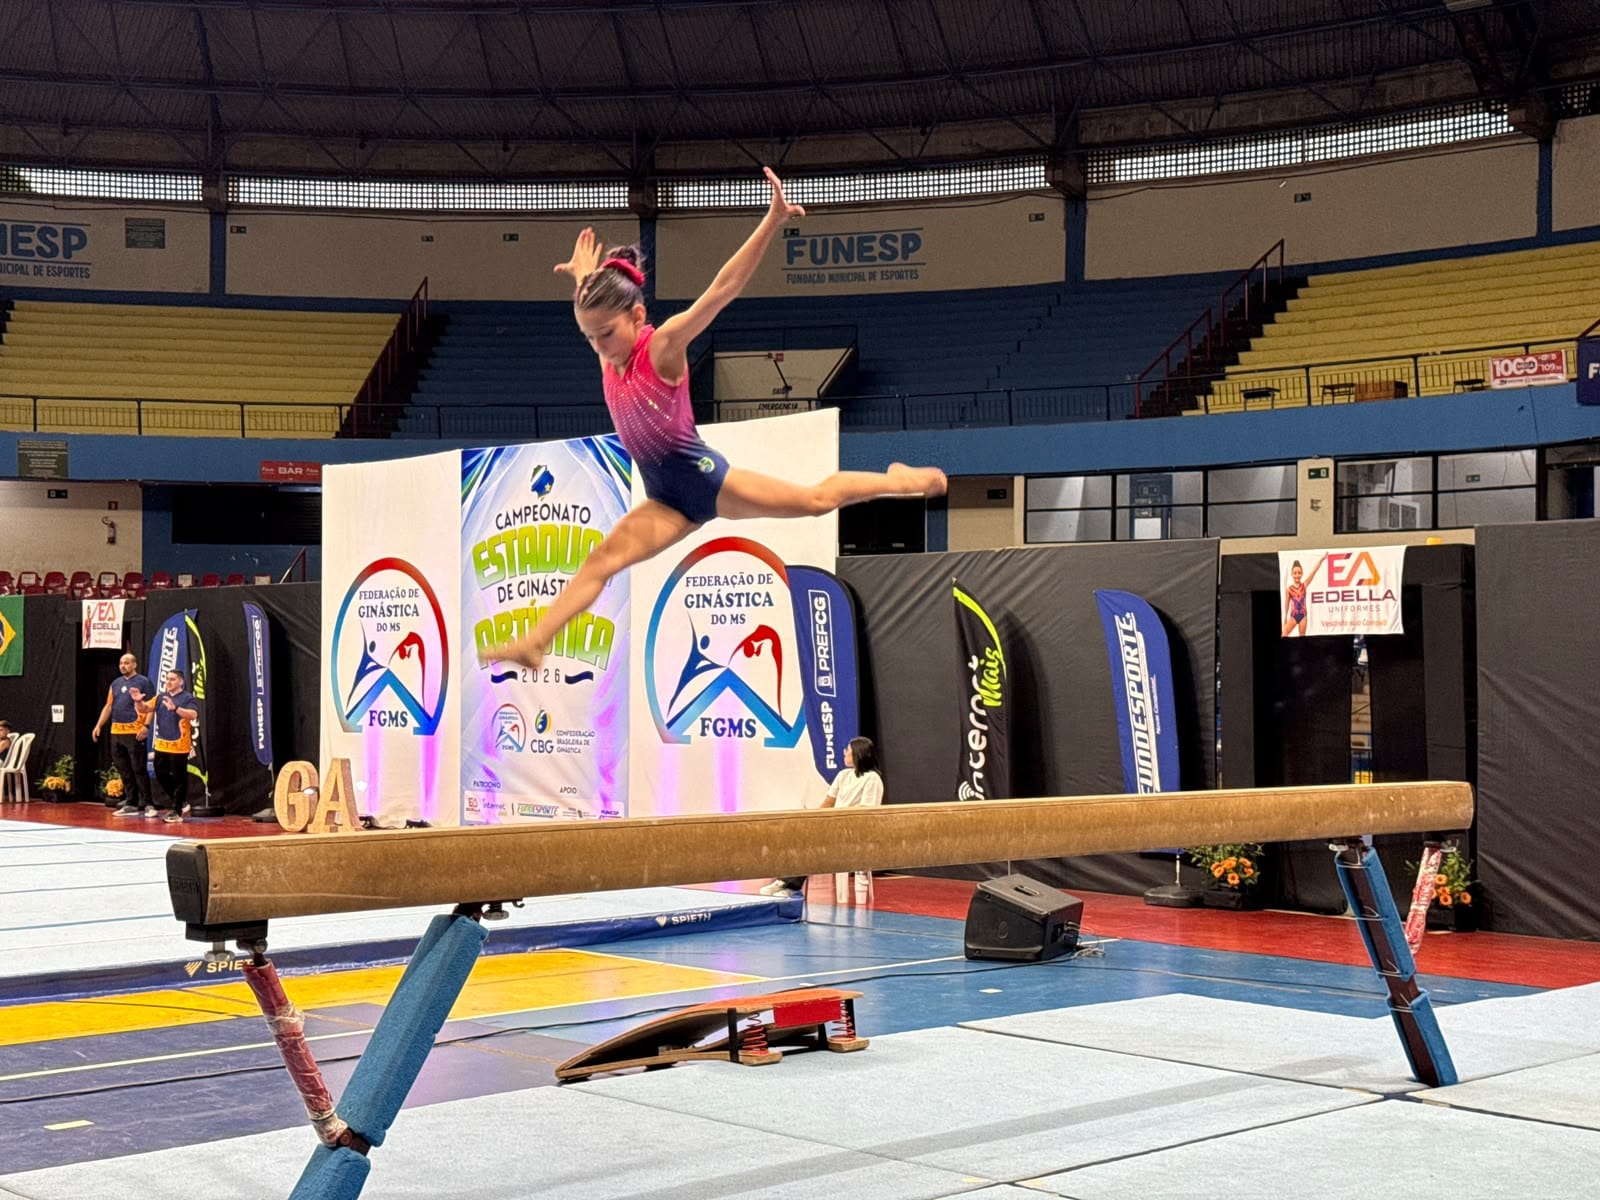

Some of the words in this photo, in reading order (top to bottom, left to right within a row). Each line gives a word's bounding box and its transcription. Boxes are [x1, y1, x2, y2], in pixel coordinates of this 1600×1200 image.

[786, 233, 922, 266] FUNESP
[33, 264, 45, 276] DE
[46, 265, 90, 279] ESPORTES
[828, 271, 866, 284] MUNICIPAL
[868, 270, 878, 281] DE
[880, 269, 919, 281] ESPORTES
[278, 466, 304, 475] BAR
[495, 503, 591, 530] CAMPEONATO
[686, 572, 754, 588] FEDERAÇÃO
[757, 573, 774, 585] DE
[359, 587, 407, 602] FEDERAÇÃO
[408, 588, 420, 598] DE
[497, 584, 513, 604] DE
[517, 575, 572, 598] GINÁST
[1311, 589, 1396, 604] EDELLA
[684, 589, 774, 609] GINÁSTICA
[358, 601, 420, 618] GINÁSTICA
[1328, 604, 1381, 613] UNIFORMES
[376, 623, 388, 632] DO
[389, 622, 401, 632] MS
[711, 614, 726, 625] DO
[730, 613, 746, 624] MS
[814, 596, 831, 672] PREFCG
[521, 668, 561, 684] 2026
[979, 646, 1003, 707] Mais
[369, 710, 408, 728] FGMS
[700, 717, 757, 738] FGMS
[821, 701, 838, 769] FUNESP
[530, 739, 554, 754] CBG
[274, 758, 364, 833] GA
[560, 786, 577, 794] APOIO
[671, 912, 712, 926] SPIETH
